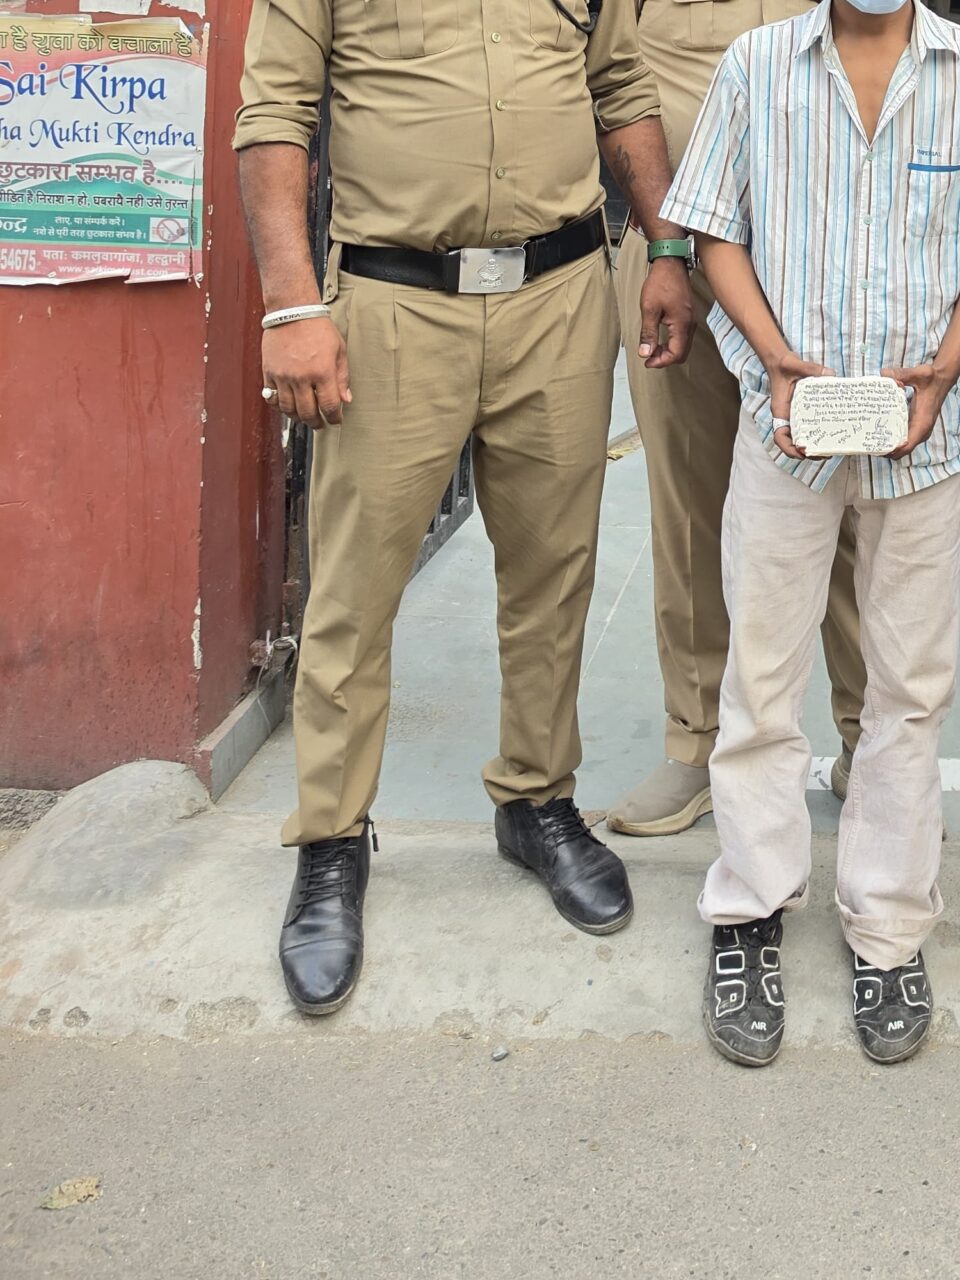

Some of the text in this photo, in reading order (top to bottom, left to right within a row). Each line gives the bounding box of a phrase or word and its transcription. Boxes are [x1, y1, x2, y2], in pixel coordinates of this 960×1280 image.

[12, 25, 28, 51] है
[31, 32, 74, 56] युवा
[77, 28, 104, 52] को
[60, 63, 168, 115] Kirpa
[29, 119, 99, 150] Mukti
[107, 122, 197, 155] Kendra
[76, 164, 138, 183] सम्भव
[36, 191, 65, 205] निराश
[67, 195, 76, 205] न
[147, 195, 162, 209] उसे
[887, 1020, 905, 1032] AIR
